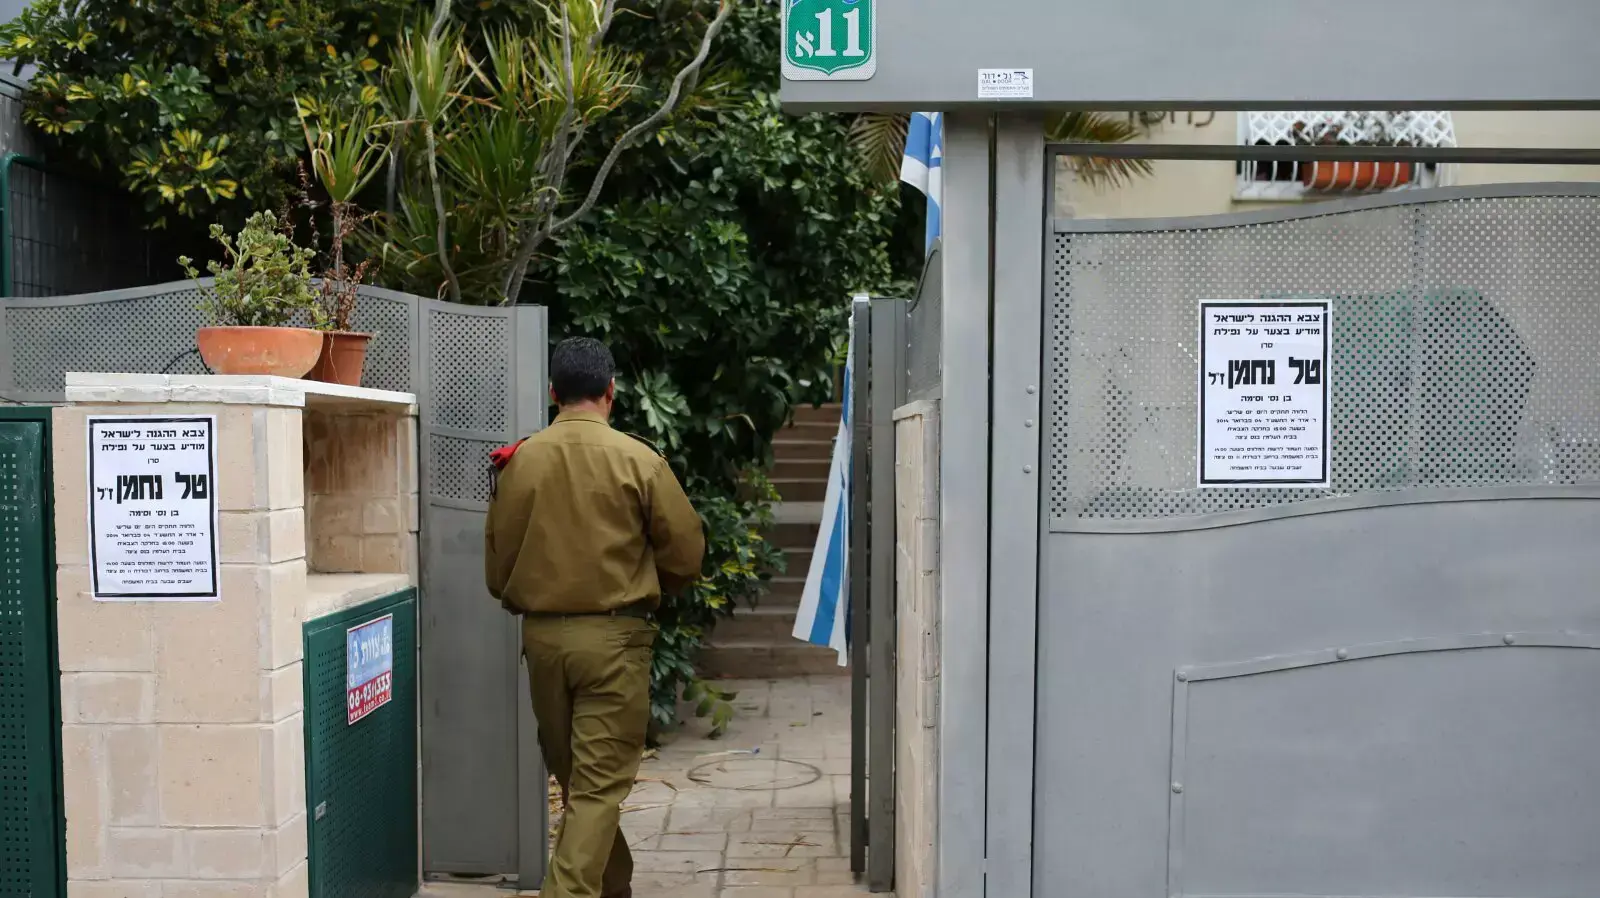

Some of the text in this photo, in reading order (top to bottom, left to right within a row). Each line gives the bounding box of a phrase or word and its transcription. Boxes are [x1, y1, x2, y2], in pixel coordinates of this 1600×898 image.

[1213, 314, 1254, 322] לישראל
[1228, 359, 1275, 389] נחמן
[1288, 356, 1321, 385] טל
[101, 429, 141, 438] לישראל
[116, 475, 163, 504] נחמן
[175, 471, 208, 499] טל
